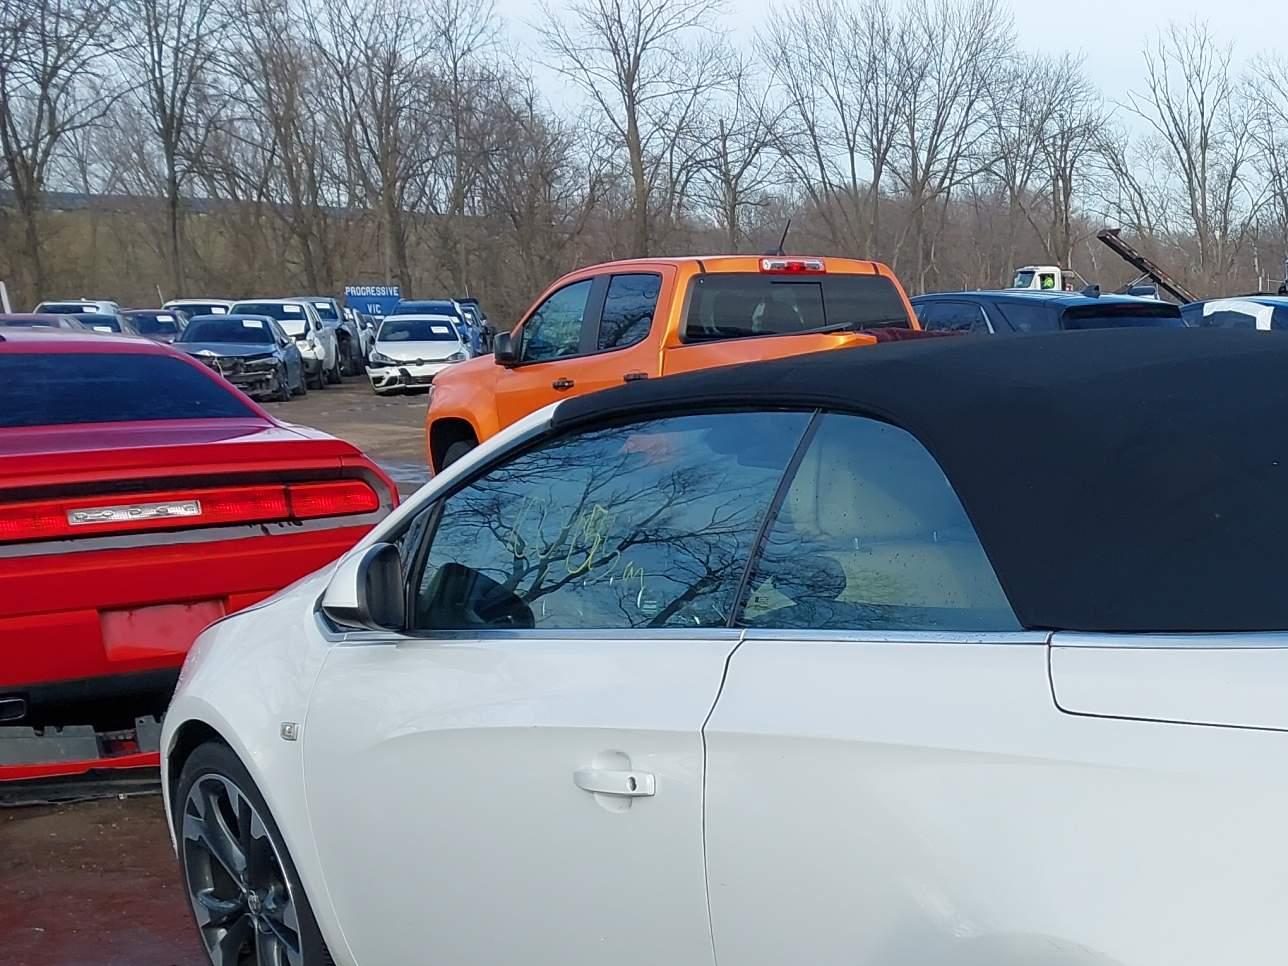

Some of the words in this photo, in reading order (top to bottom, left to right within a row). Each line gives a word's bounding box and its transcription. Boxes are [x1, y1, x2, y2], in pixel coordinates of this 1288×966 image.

[344, 286, 399, 296] PROGRESSIVE
[366, 303, 382, 314] VIC
[73, 504, 196, 521] DODGE
